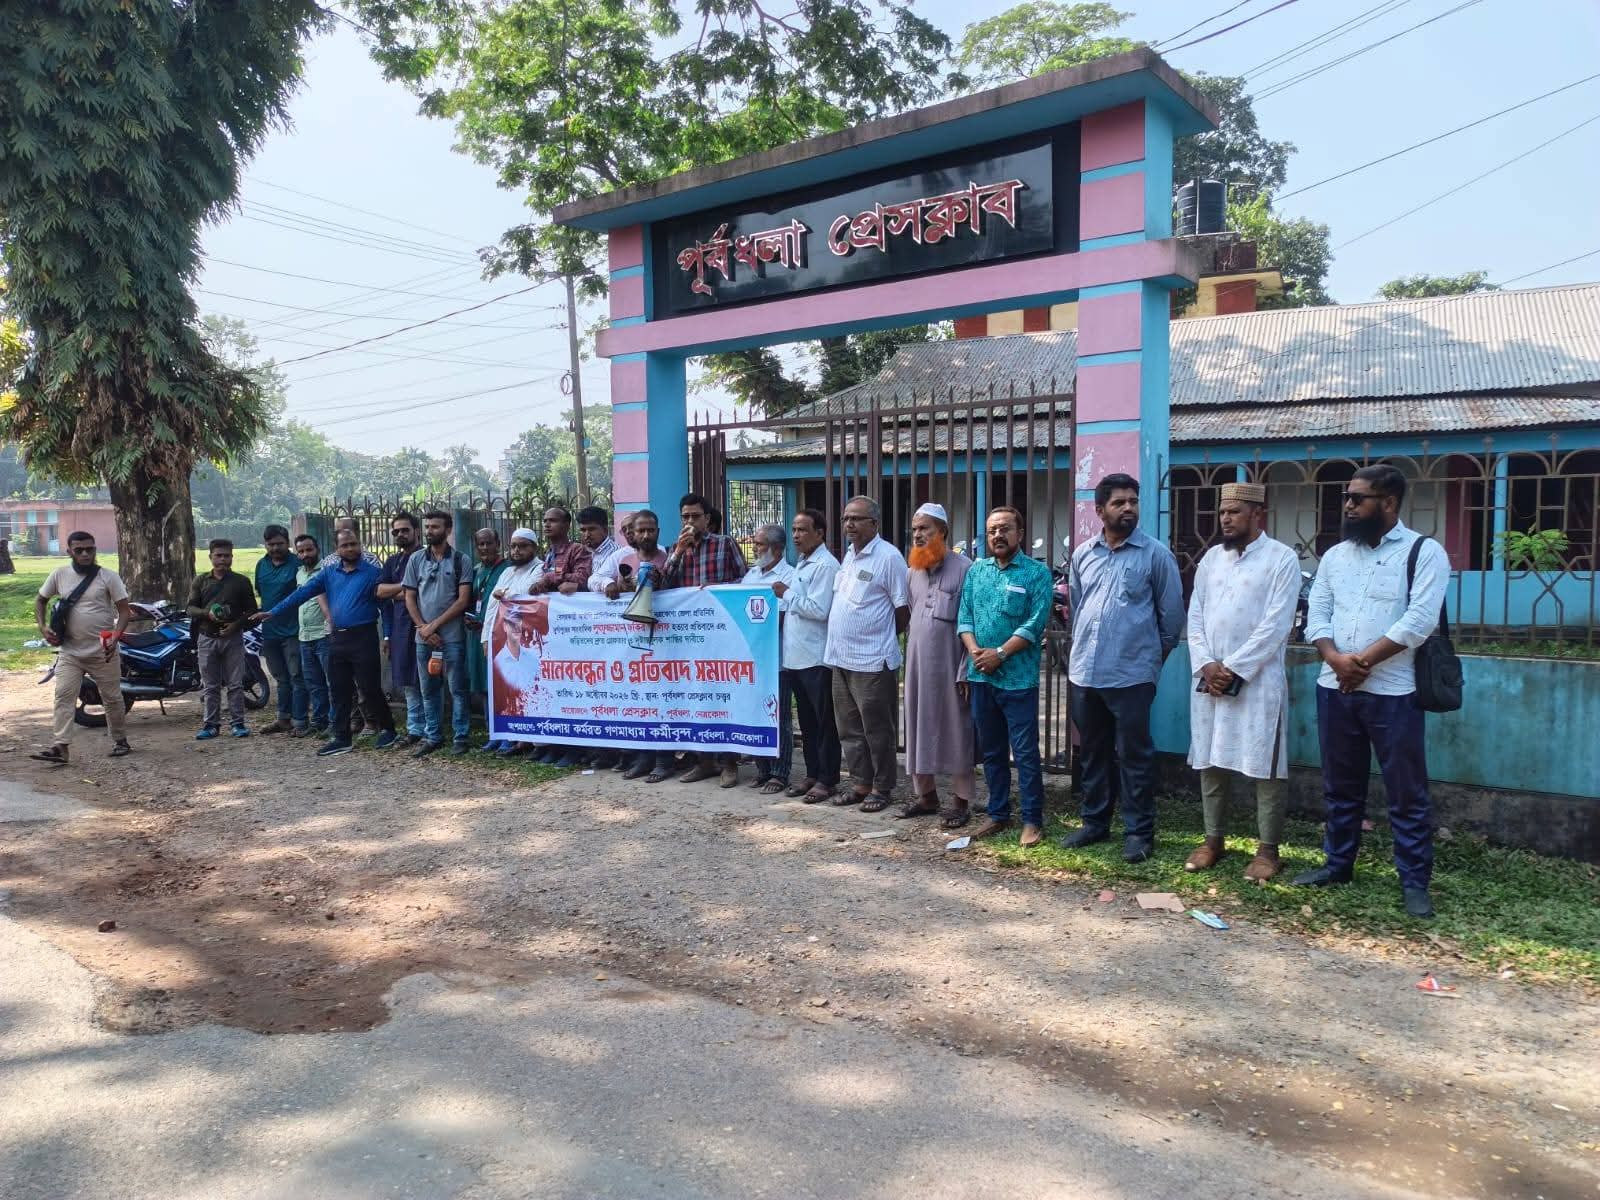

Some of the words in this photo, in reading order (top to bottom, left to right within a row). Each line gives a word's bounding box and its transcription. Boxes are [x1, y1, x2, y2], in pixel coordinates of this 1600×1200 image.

[677, 222, 806, 296] পূর্বধলা
[828, 179, 1024, 256] প্রেসক্লাব
[540, 660, 606, 685] মানববন্ধন
[611, 661, 624, 683] ও
[629, 651, 690, 684] প্রতিবাদ
[695, 660, 755, 684] সমাবেশ
[573, 722, 602, 736] কর্মরত
[605, 725, 646, 738] গণমাধ্যম
